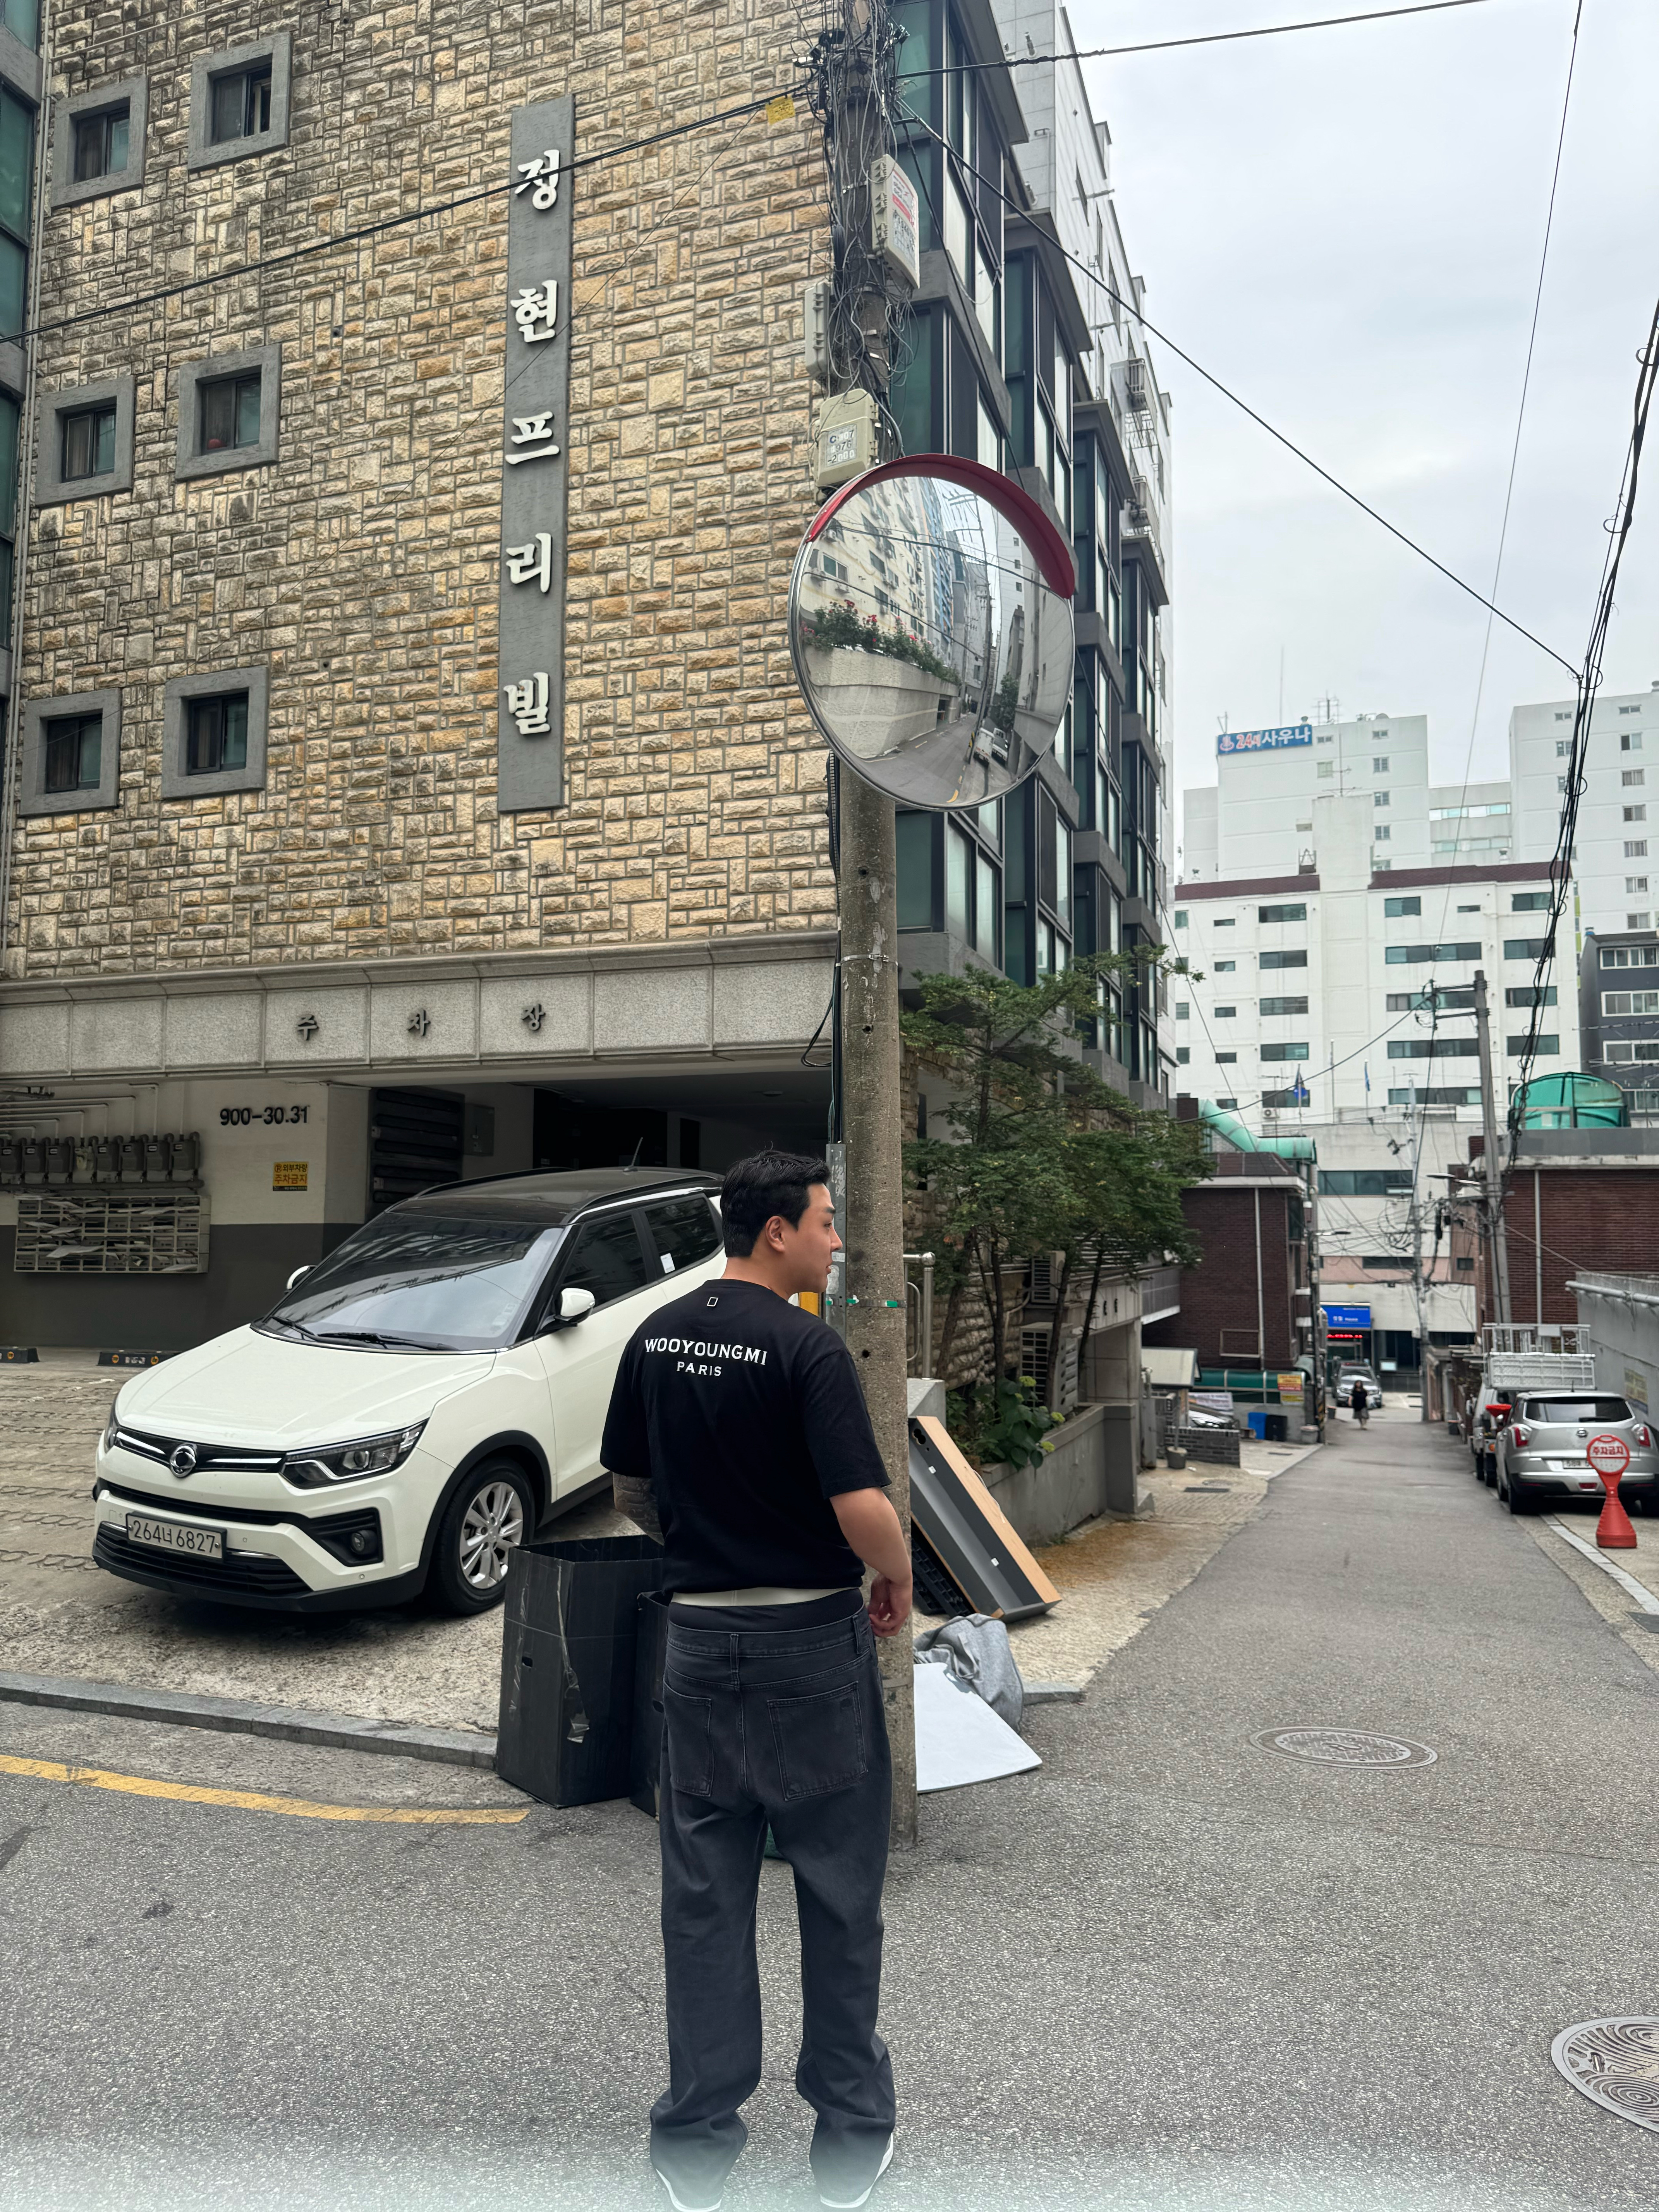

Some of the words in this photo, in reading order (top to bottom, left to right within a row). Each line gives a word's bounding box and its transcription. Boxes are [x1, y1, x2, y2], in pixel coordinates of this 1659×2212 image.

[503, 149, 560, 735] 정현프리빌
[1261, 726, 1311, 746] 사우나
[220, 1106, 308, 1126] 900-30.31
[283, 1163, 307, 1172] 외부차량
[274, 1174, 307, 1184] 주차금지
[645, 1338, 768, 1365] WOOYOUNGMI
[677, 1361, 722, 1377] PARIS
[1592, 1446, 1624, 1455] 주차금지
[133, 1520, 172, 1545] 264너
[176, 1529, 215, 1553] 6827
